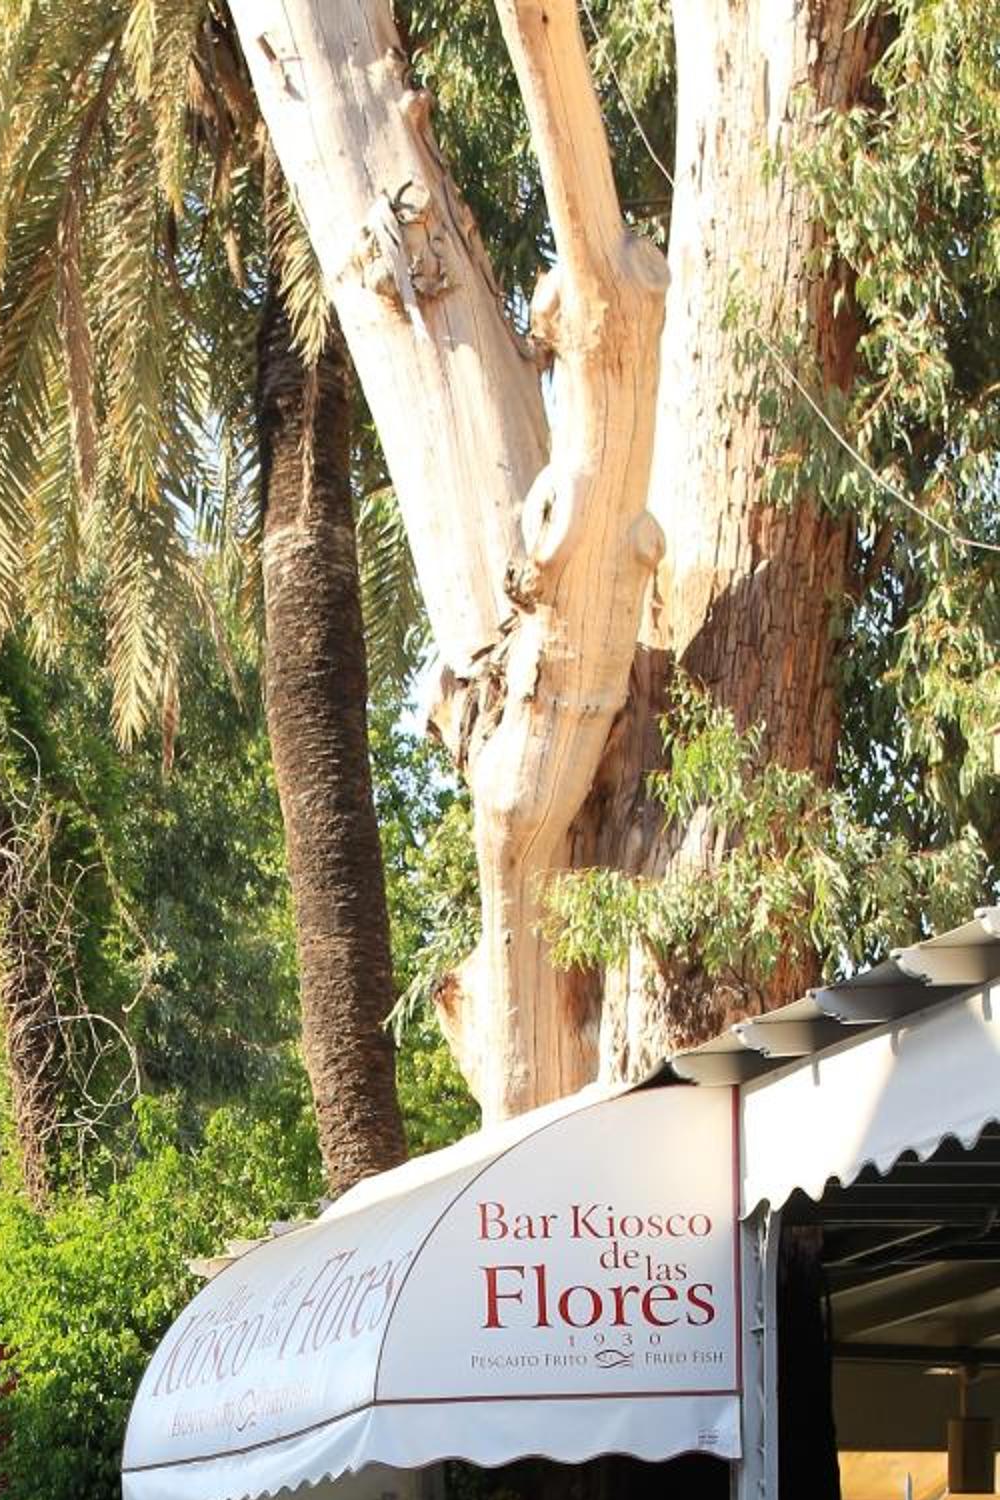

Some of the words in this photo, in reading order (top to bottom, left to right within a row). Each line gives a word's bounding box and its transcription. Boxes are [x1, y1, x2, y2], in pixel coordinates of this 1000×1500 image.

[476, 1202, 558, 1241] Bar
[570, 1203, 713, 1240] Kiosco
[599, 1241, 640, 1270] de
[645, 1255, 687, 1282] las
[480, 1263, 716, 1330] Flores
[567, 1332, 662, 1348] 1930
[692, 1351, 724, 1365] FISH
